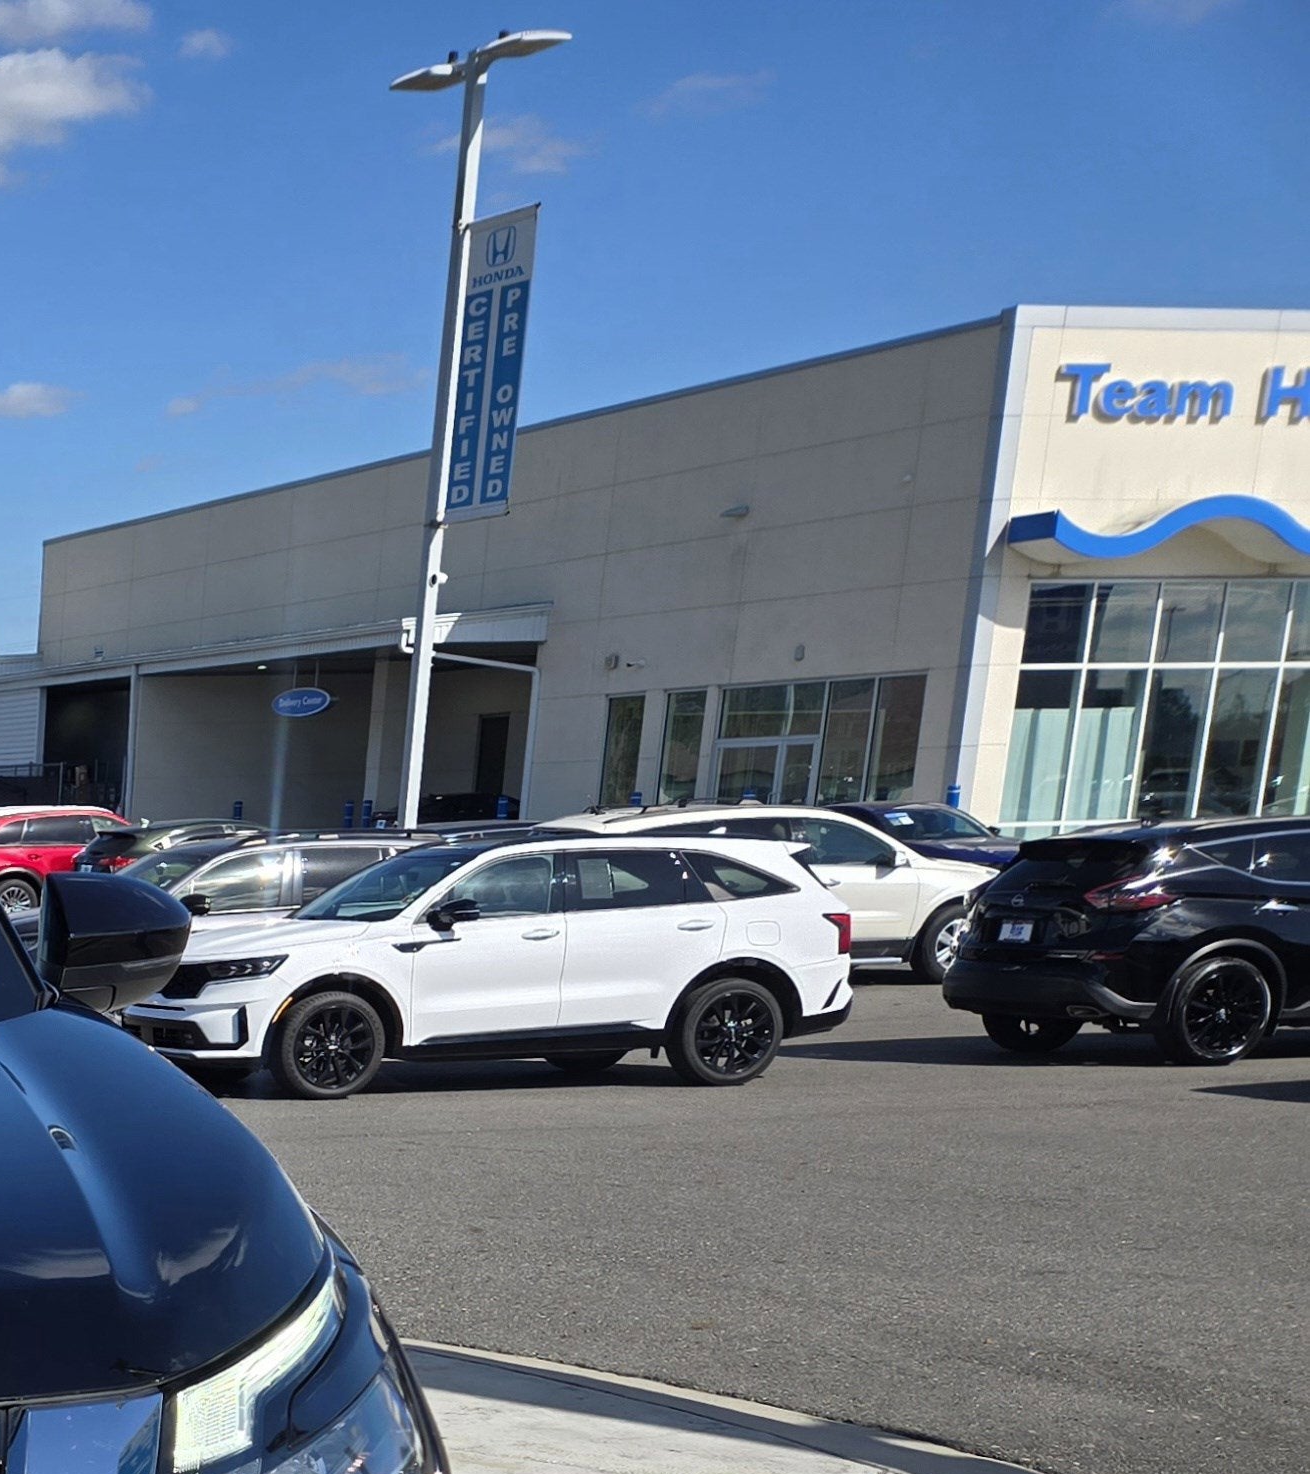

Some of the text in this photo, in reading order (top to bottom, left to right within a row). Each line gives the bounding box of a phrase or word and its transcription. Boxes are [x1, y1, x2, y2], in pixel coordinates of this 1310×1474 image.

[472, 265, 525, 288] HONDA
[450, 295, 488, 504] CERTIFIED
[486, 287, 522, 498] PRE OWNED
[1059, 362, 1234, 419] Team
